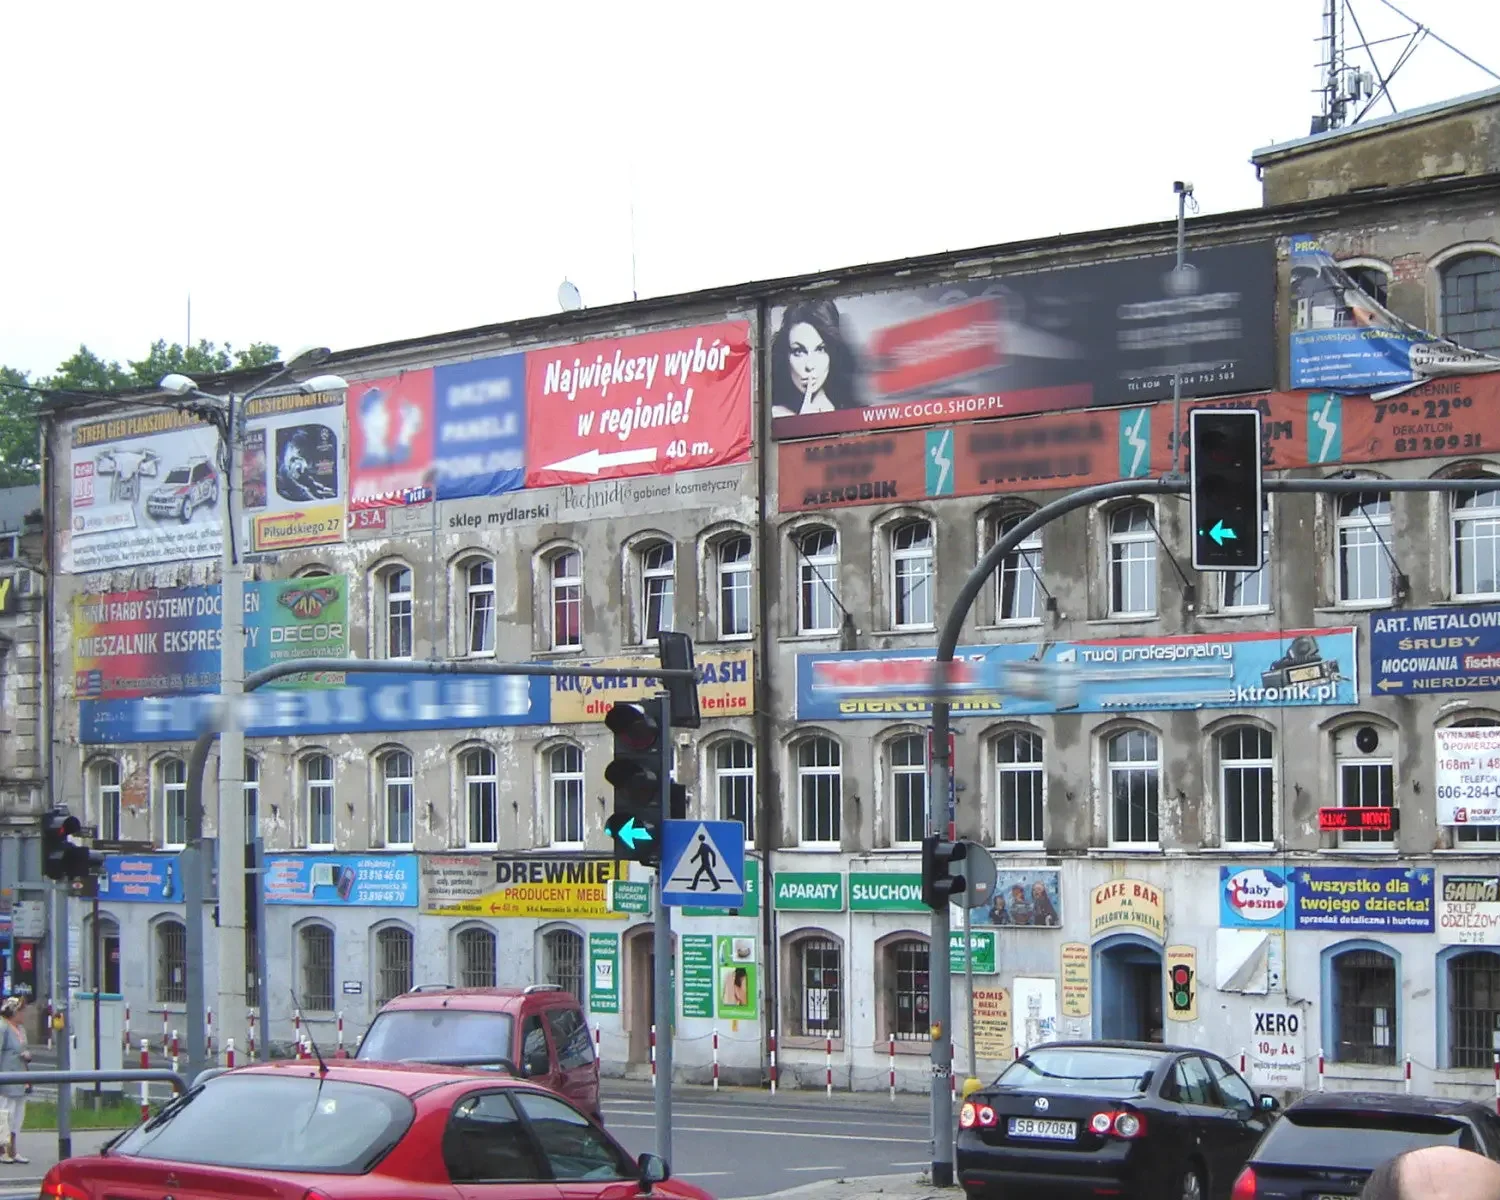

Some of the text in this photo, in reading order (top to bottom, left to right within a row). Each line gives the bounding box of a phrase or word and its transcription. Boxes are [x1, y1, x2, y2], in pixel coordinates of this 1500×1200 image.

[544, 349, 659, 402] Największy
[664, 337, 731, 385] wybór
[577, 387, 694, 442] w regionie!
[862, 396, 1004, 423] WWW.COCO.SHOP.PL
[1392, 423, 1453, 437] DEKATLON
[665, 438, 714, 458] 40 m.
[408, 487, 427, 503] PLUS
[633, 485, 671, 502] gabinet
[674, 478, 740, 496] kosmetyczny
[327, 518, 340, 531] 27
[361, 510, 384, 526] S.A.
[449, 503, 550, 528] sklep mydlarski
[110, 601, 144, 621] FARBY
[145, 597, 196, 620] SYSTEMY
[196, 588, 260, 616] DOCEŃ
[270, 623, 343, 643] DECOR
[1374, 618, 1411, 634] ART.
[78, 632, 158, 657] MIESZALNIK
[1122, 643, 1233, 662] profesjonalny
[1398, 636, 1481, 651] ŚRUBY
[1381, 656, 1459, 673] MOCOWANIA
[701, 692, 748, 710] tenisa
[1229, 681, 1337, 703] ektronik.pl
[1460, 775, 1498, 784] TELEFON
[504, 888, 608, 902] PRODUCENT MEBL
[779, 883, 922, 900] APARATY SŁUCHOW
[1095, 883, 1158, 907] CAFE BAR
[1310, 877, 1410, 895] wszystko dla
[1300, 896, 1430, 914] twojego dziecka!
[1447, 902, 1477, 914] SKLEP
[1300, 915, 1430, 926] sprzedaż detaliczna i hurtowa
[973, 991, 1003, 1001] KOMIS
[1255, 1012, 1299, 1033] XERO
[1017, 1120, 1034, 1133] SB
